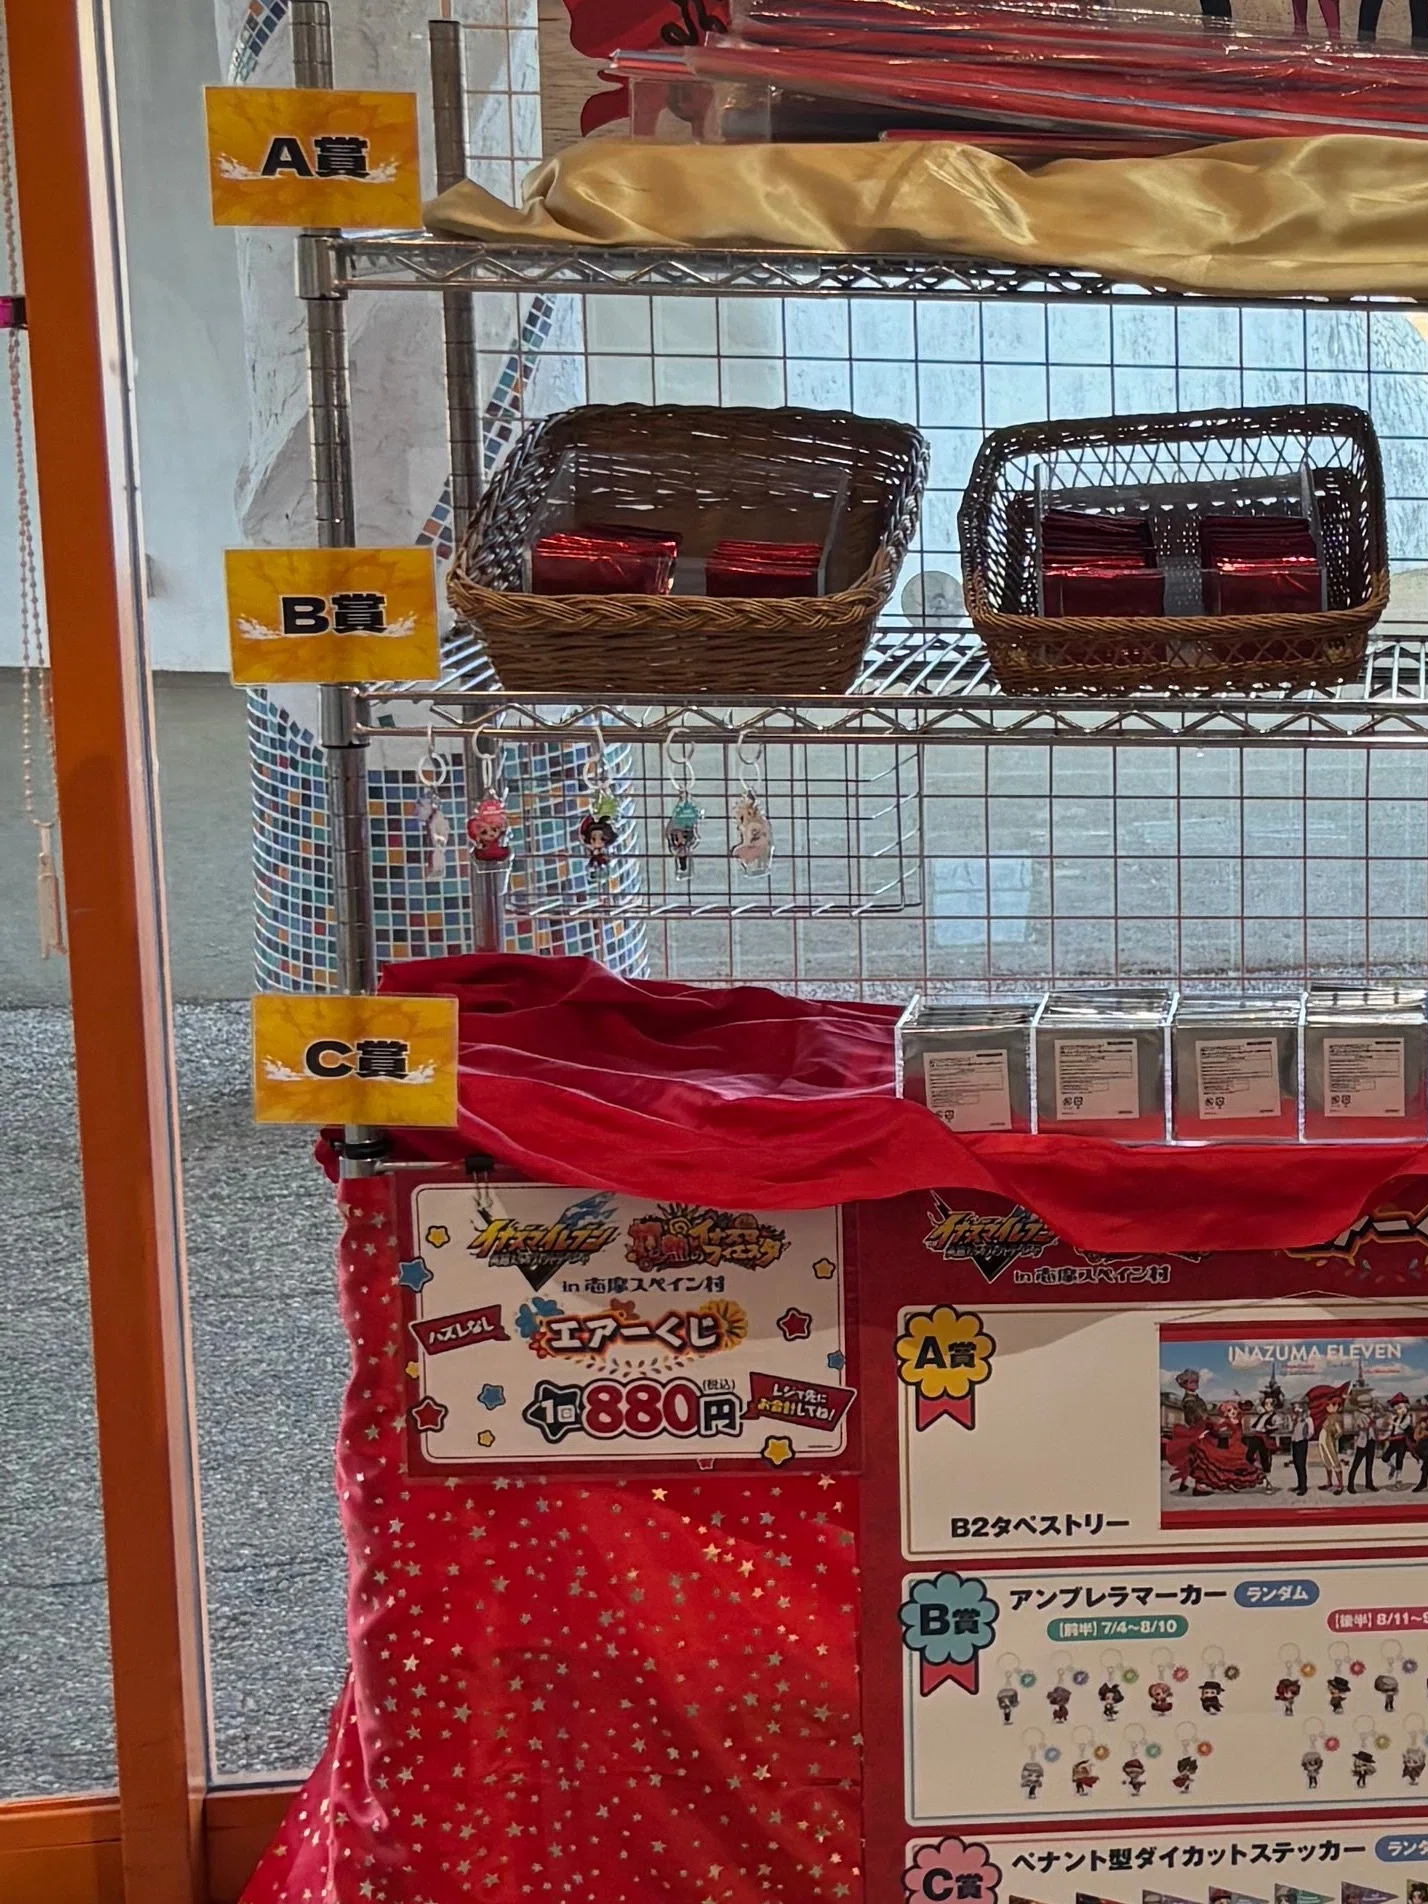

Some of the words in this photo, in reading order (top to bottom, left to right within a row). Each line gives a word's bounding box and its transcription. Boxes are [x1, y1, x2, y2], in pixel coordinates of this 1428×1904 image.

[261, 136, 371, 179] A賞
[281, 593, 387, 635] B賞
[305, 1039, 410, 1080] C賞
[427, 1318, 496, 1346] ハズレなし
[550, 1312, 720, 1352] エアーくじ
[914, 1335, 978, 1370] A賞
[1228, 1345, 1321, 1363] INAZUMA
[1327, 1343, 1402, 1360] ELEVEN
[951, 1513, 1130, 1540] B2タペストリー
[1010, 1583, 1228, 1611] アンブレラマーカー
[1246, 1585, 1310, 1603] ランダム
[918, 1602, 981, 1636] B賞
[1012, 1839, 1367, 1874] ペナント型ダイカットステッカー
[922, 1867, 985, 1902] C賞
